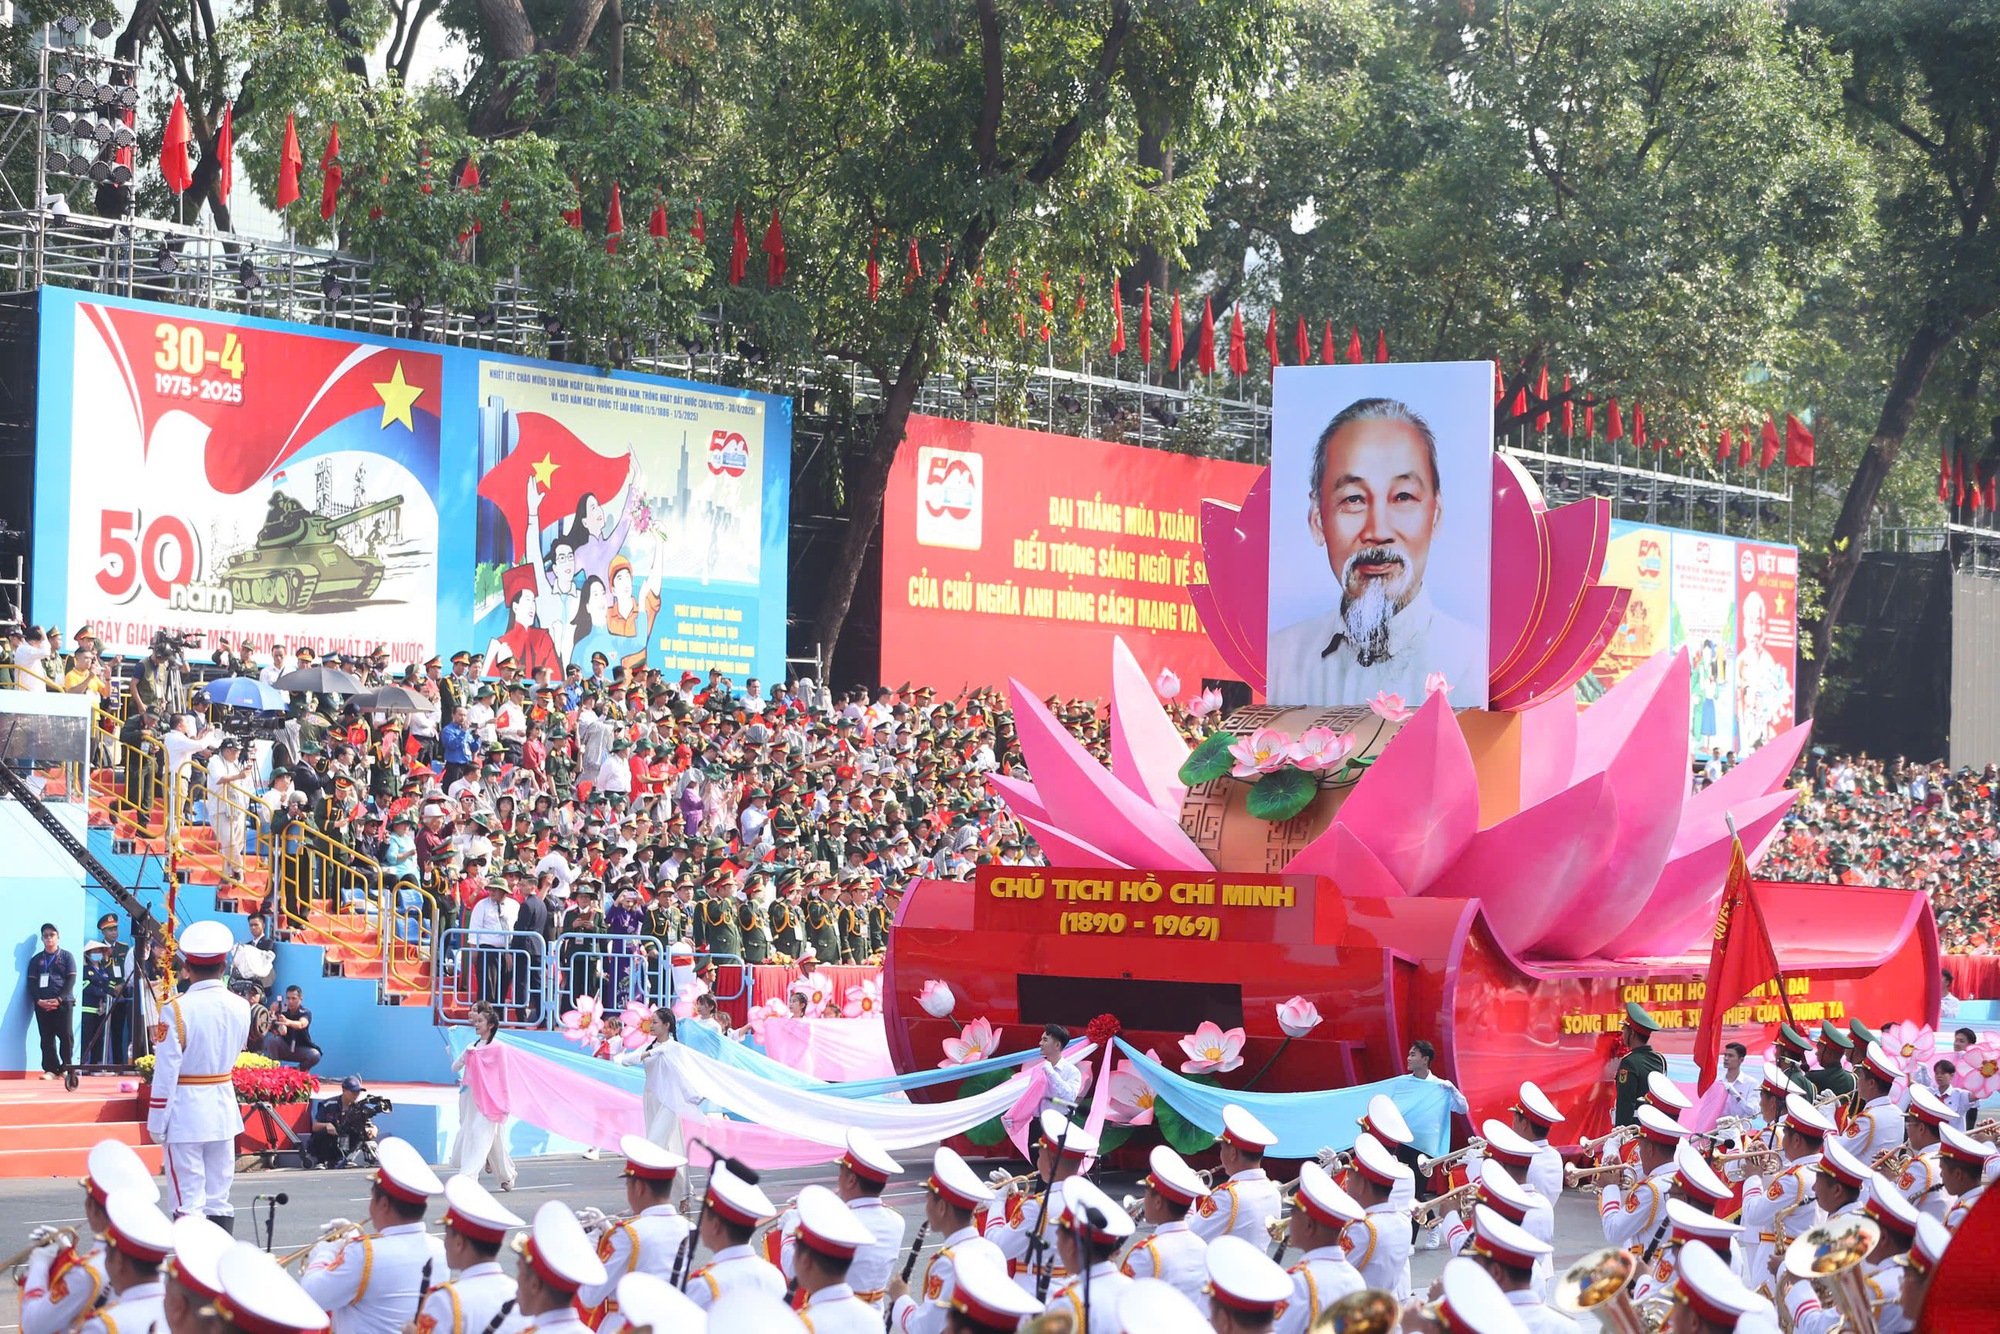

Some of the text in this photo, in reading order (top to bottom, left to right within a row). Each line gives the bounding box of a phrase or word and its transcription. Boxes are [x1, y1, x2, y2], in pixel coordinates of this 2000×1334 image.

[154, 322, 245, 379] 30-4
[154, 373, 243, 403] 1975-2025
[1049, 496, 1073, 533] ĐẠI
[1077, 491, 1122, 534] THẮNG
[1125, 502, 1155, 538] MÙA
[1158, 508, 1195, 543] XUÂN
[95, 508, 195, 601] 50
[1014, 529, 1046, 571] BIỂU
[1049, 541, 1096, 580] TƯỢNG
[1098, 544, 1136, 581] SÁNG
[1139, 550, 1171, 585] NGỜI
[169, 579, 234, 614] năm
[908, 567, 939, 608] CỦA
[942, 571, 973, 612] CHỦ
[976, 579, 1021, 615] NGHĨA
[1023, 586, 1054, 618] ANH
[1057, 585, 1095, 622] HÙNG
[1098, 589, 1135, 626] CÁCH
[1138, 598, 1177, 635] MẠNG
[989, 872, 1297, 908] CHỦ TỊCH HỒ CHÍ MINH
[1059, 911, 1126, 936] (1890
[1151, 914, 1221, 942] 1969)
[1655, 983, 1683, 1006] TỊCH
[1828, 1001, 1845, 1018] TA
